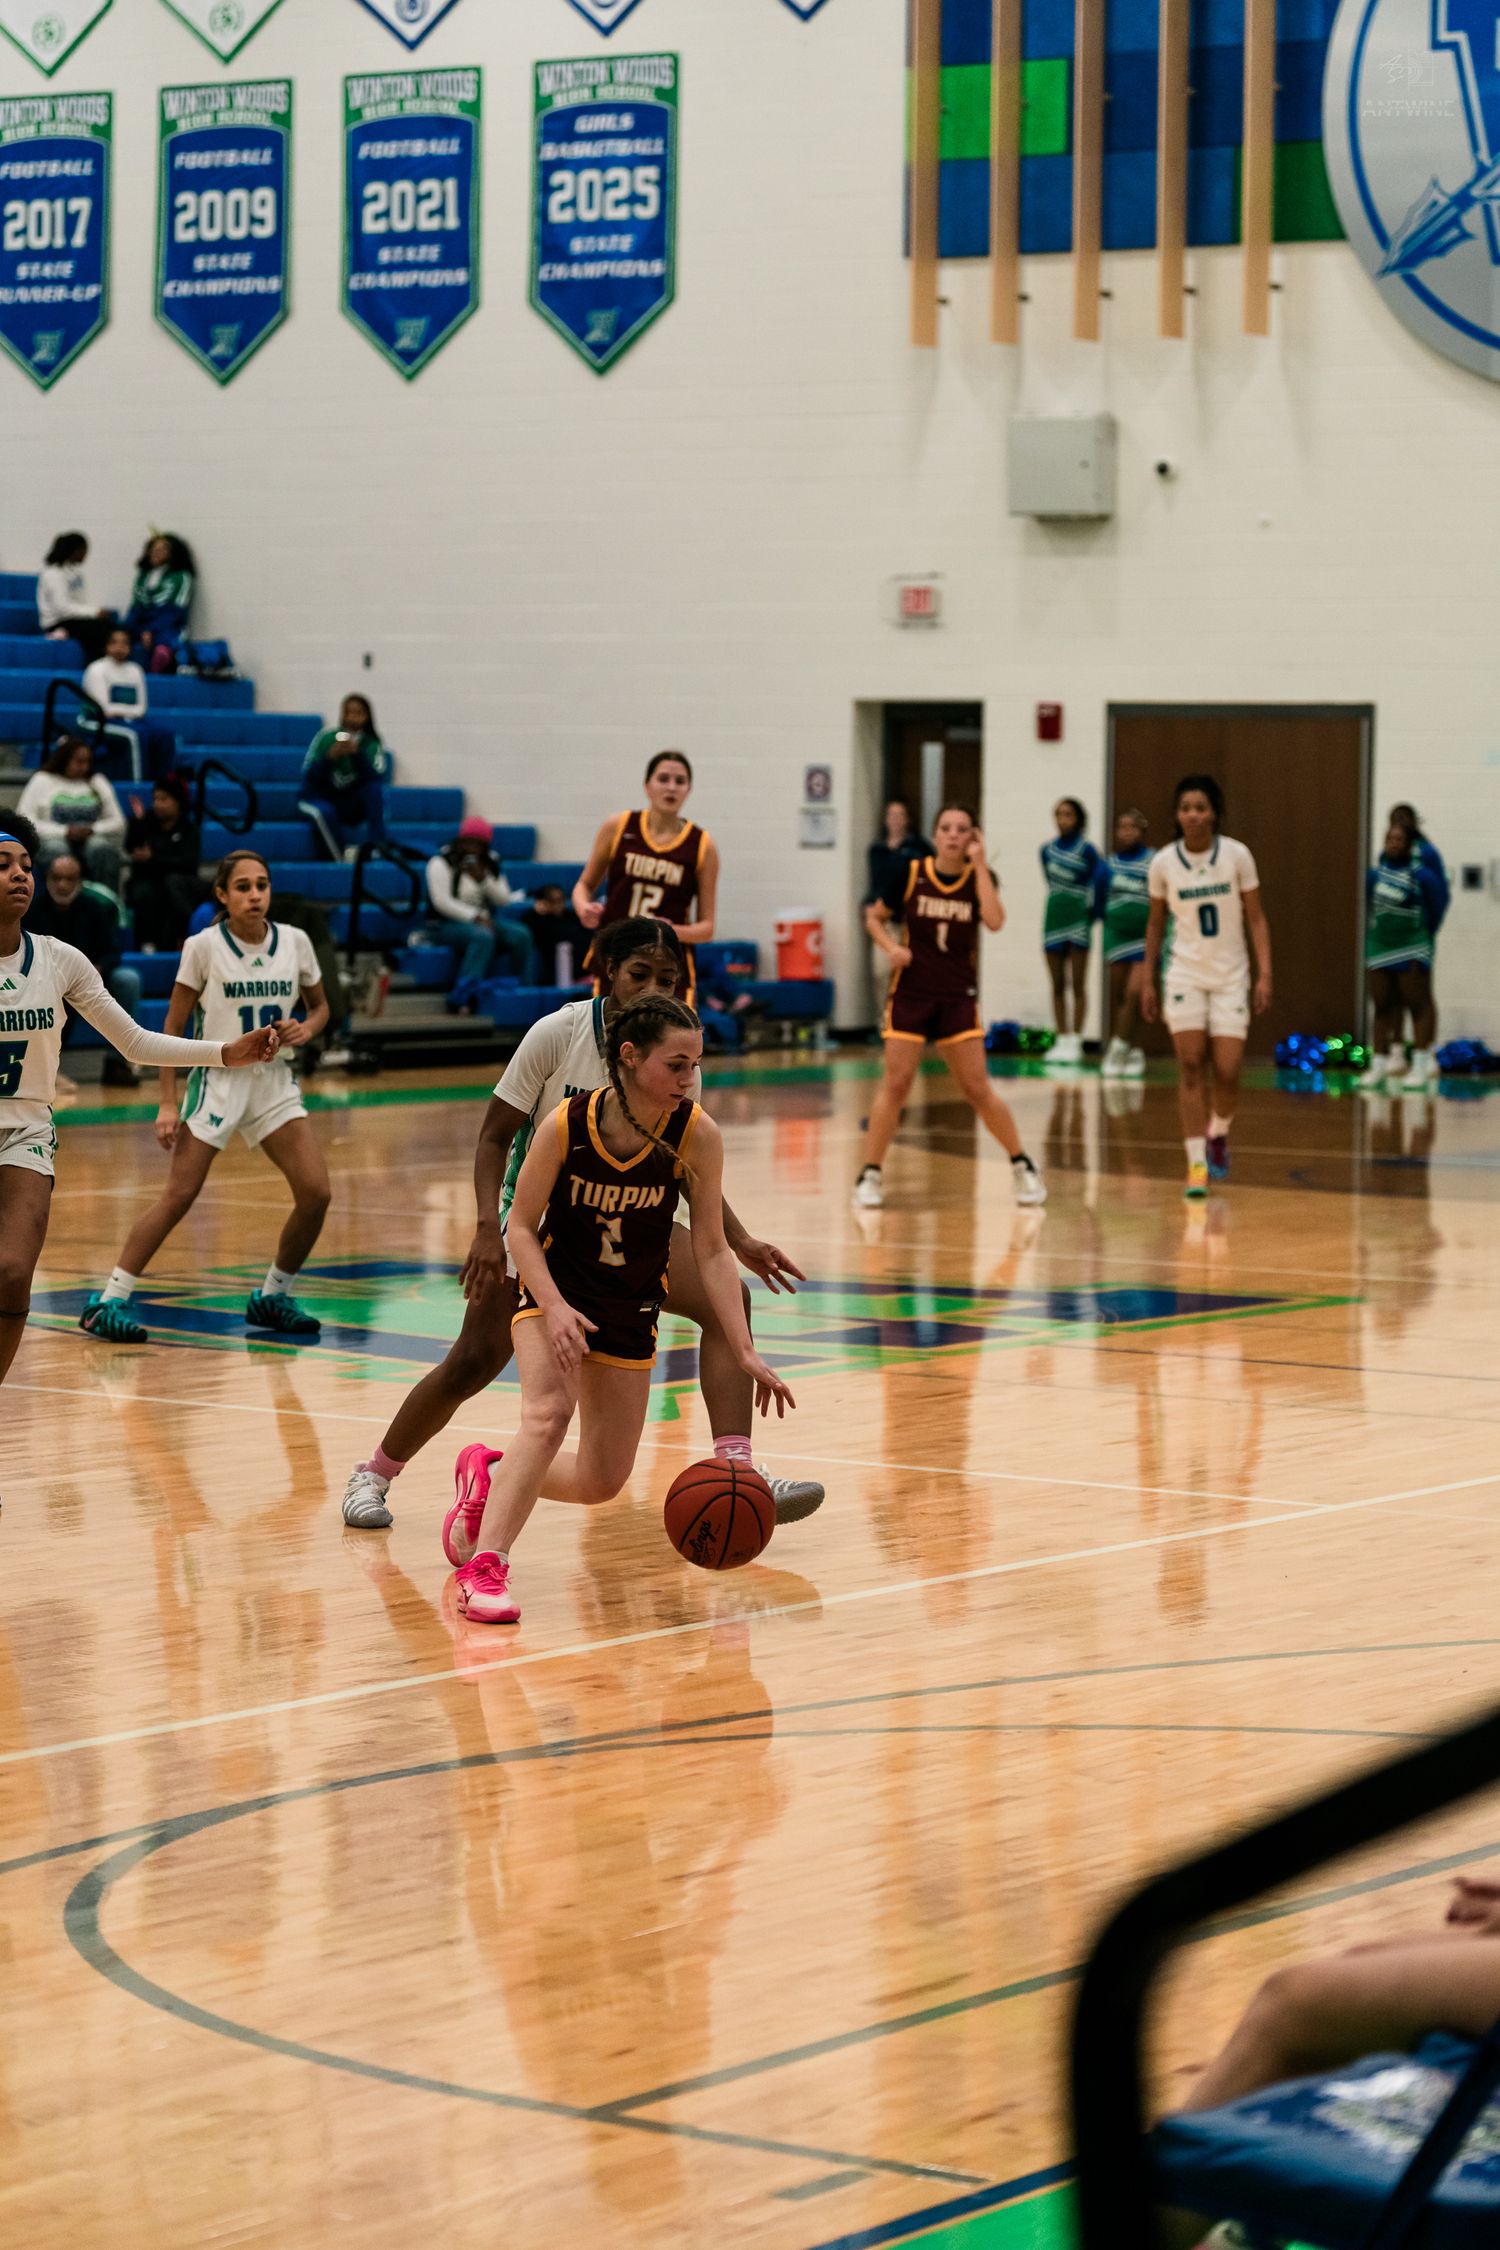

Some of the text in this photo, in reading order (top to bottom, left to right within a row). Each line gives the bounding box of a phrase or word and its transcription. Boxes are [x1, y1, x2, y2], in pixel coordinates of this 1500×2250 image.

[574, 112, 636, 134] GIRLS
[174, 147, 274, 170] FOOTBALL
[358, 136, 461, 160] FOOTBALL
[0, 158, 95, 180] FOOTBALL
[361, 176, 461, 234] 2021
[547, 165, 661, 224] 2025
[3, 196, 93, 251] 2017
[174, 186, 277, 243] 2009
[377, 243, 443, 265] STATE
[569, 233, 636, 256] STATE
[16, 259, 76, 281] STATE
[192, 251, 255, 273] STATE
[538, 258, 667, 282] CHAMPIONS
[163, 275, 283, 298] CHAMPIONS
[348, 267, 468, 290] CHAMPIONS
[0, 282, 102, 304] UNNER-UP
[625, 852, 685, 887] TURPIN
[628, 881, 665, 920] 12
[917, 894, 973, 922] TURPIN
[1198, 902, 1219, 938] 0
[222, 980, 293, 998] WARRIORS
[570, 1174, 666, 1213] TURPIN
[596, 1213, 627, 1267] 2
